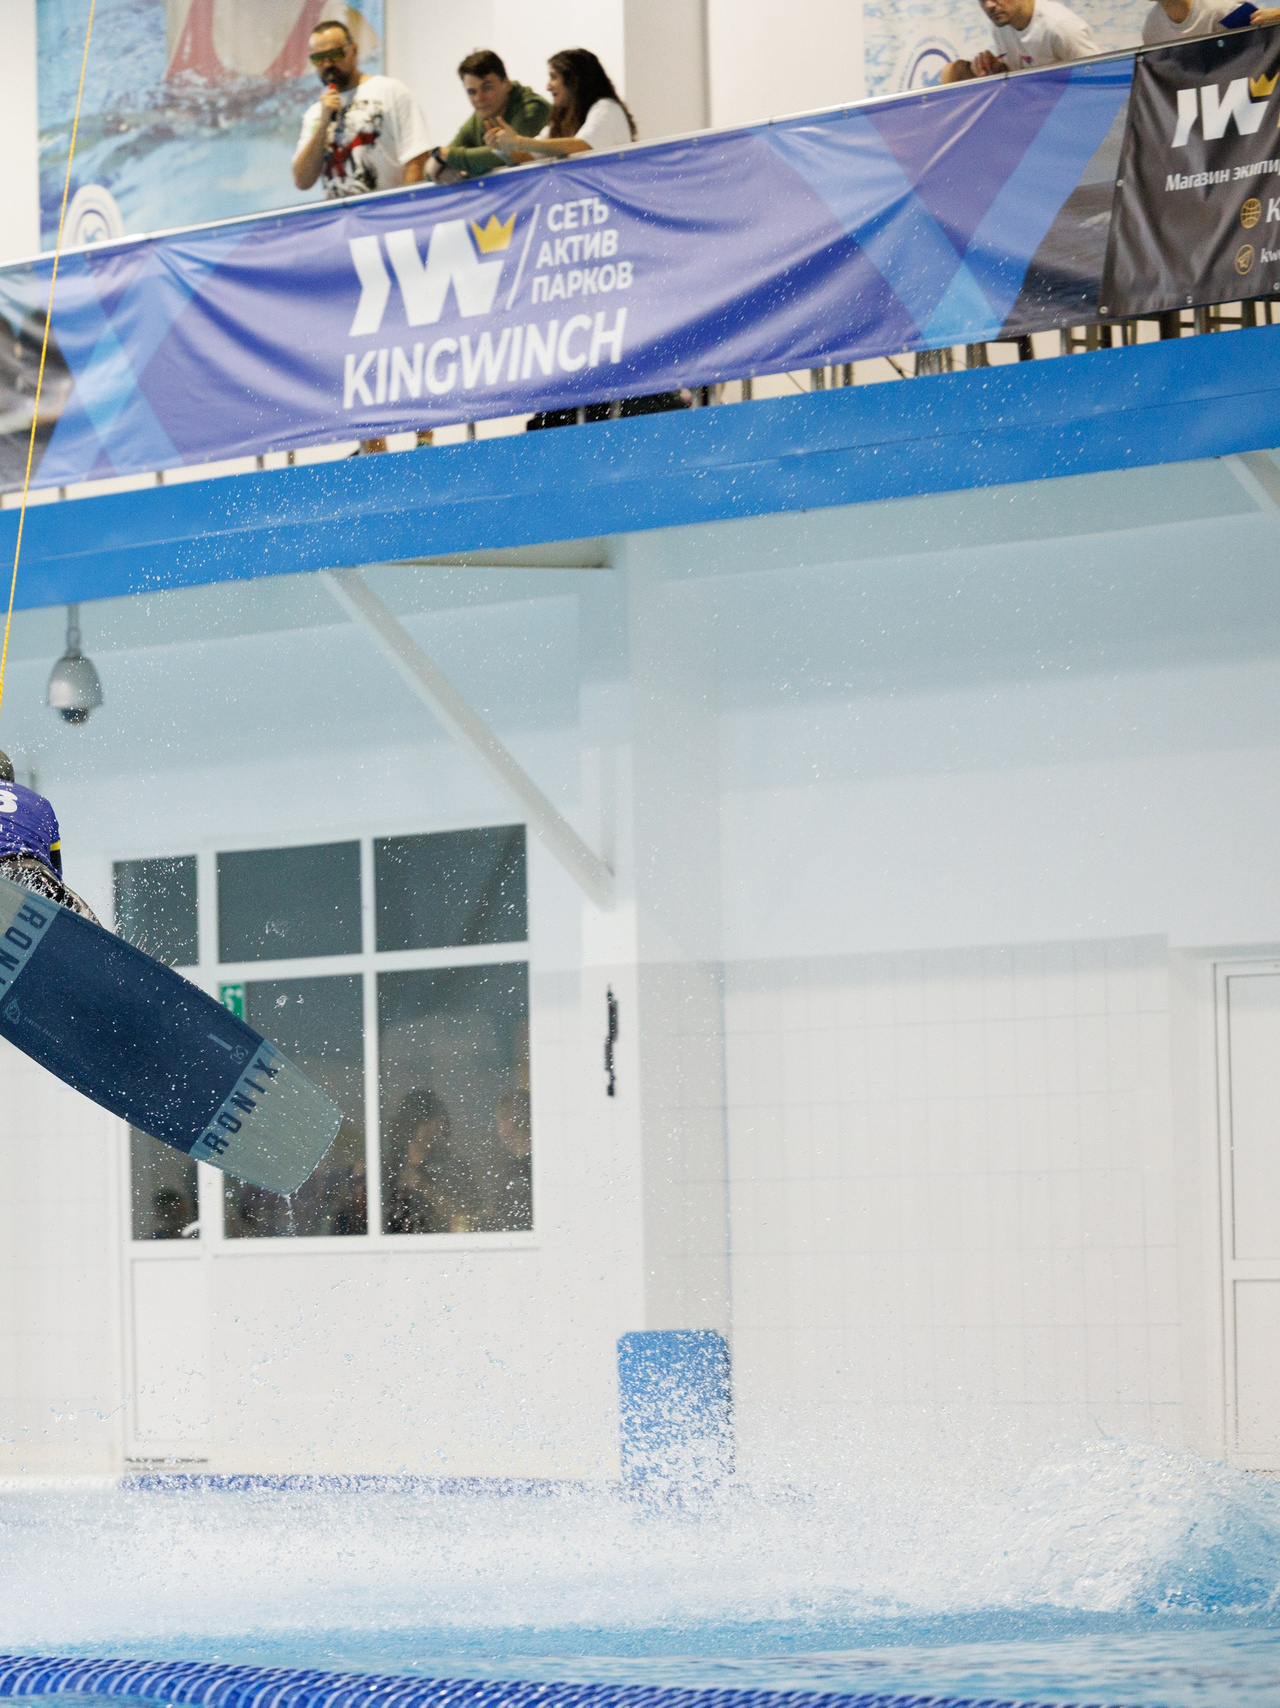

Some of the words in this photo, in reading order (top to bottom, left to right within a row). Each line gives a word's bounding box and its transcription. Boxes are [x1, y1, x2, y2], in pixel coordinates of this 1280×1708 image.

[1165, 168, 1231, 192] Магазин
[547, 197, 610, 232] СЕТЬ
[536, 229, 619, 270] АКТИВ
[531, 261, 634, 305] ПАРКОВ
[343, 307, 629, 410] KINGWINCH
[202, 1057, 280, 1156] RONIX
